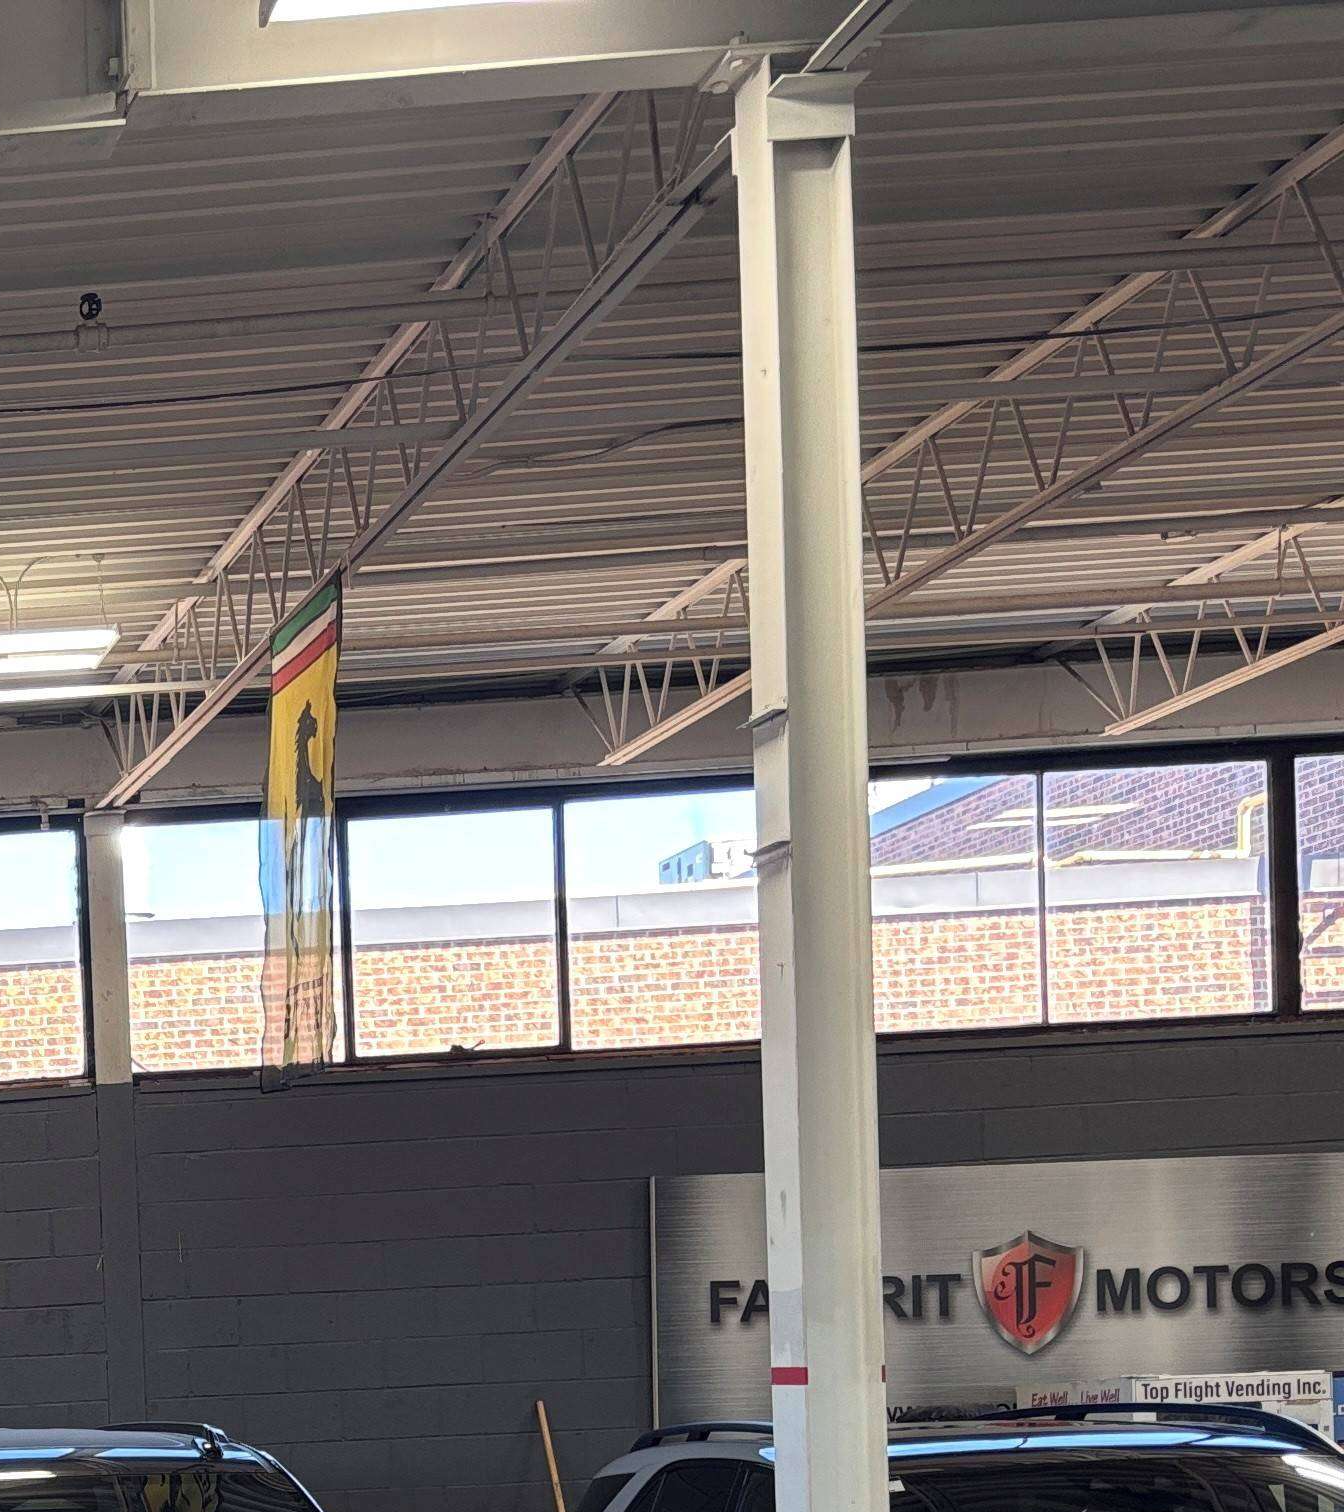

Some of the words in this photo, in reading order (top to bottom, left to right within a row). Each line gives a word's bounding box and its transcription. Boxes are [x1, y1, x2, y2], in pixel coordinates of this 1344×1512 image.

[709, 1273, 962, 1324] FARIT
[1141, 1383, 1170, 1401] Top
[1175, 1381, 1221, 1401] Flight
[1226, 1379, 1292, 1399] Vending
[1297, 1378, 1326, 1394] Inc.
